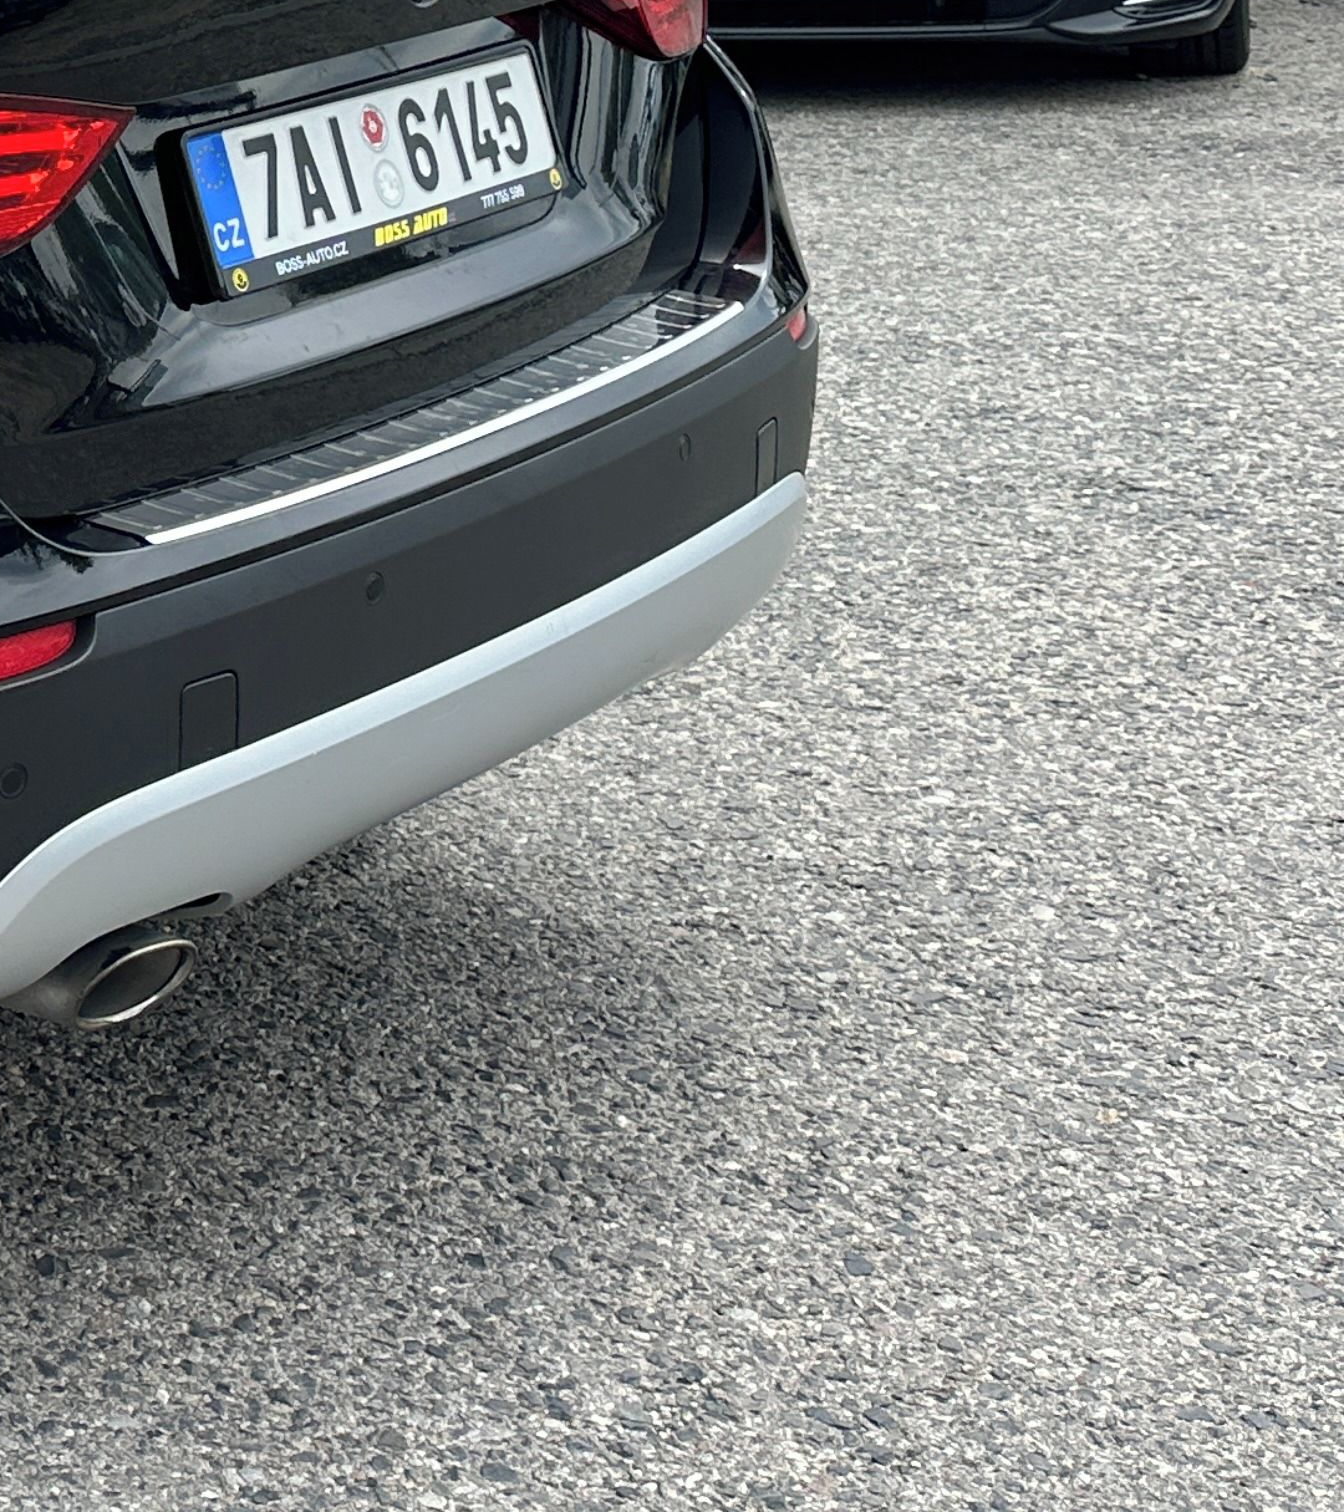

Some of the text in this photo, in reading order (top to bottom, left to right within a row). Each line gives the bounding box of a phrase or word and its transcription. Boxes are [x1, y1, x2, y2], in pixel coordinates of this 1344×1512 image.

[398, 71, 528, 192] 6145
[213, 218, 245, 252] CZ
[374, 207, 449, 247] BOSS AUTO
